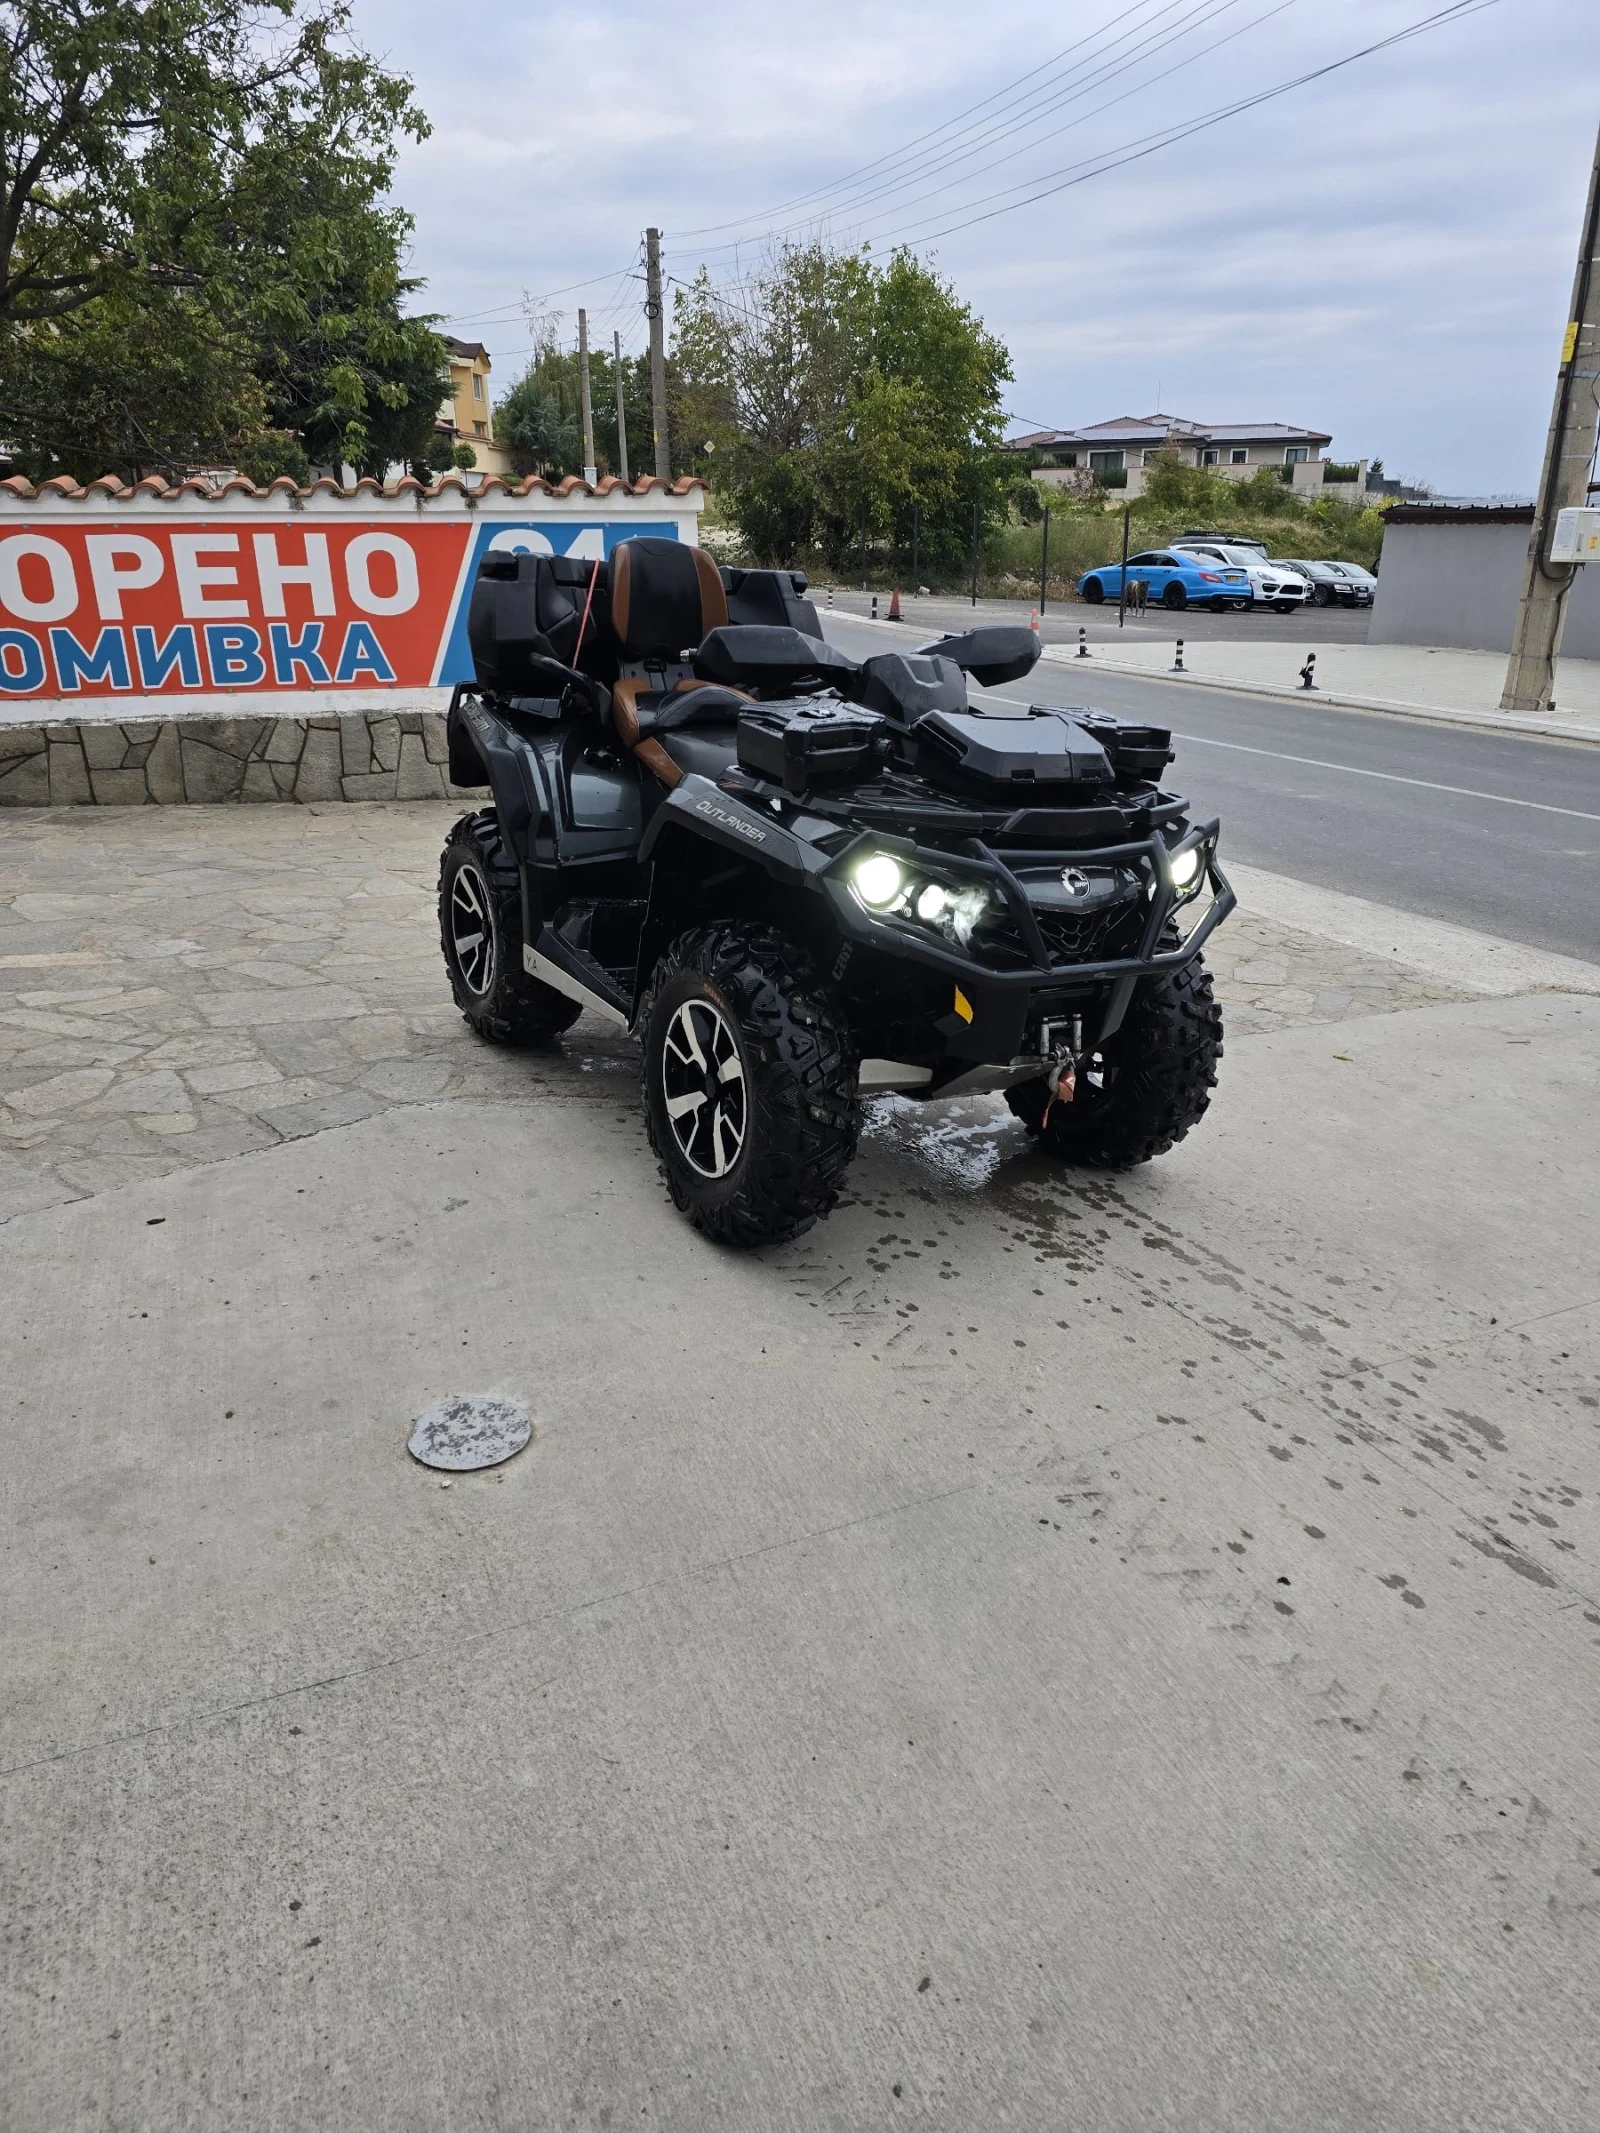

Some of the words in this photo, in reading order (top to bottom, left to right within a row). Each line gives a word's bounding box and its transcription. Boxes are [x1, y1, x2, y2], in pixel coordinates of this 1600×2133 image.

[0, 532, 420, 622] ОРЕНО
[0, 621, 398, 693] ОМИВКА
[695, 800, 767, 843] OUTLANDER
